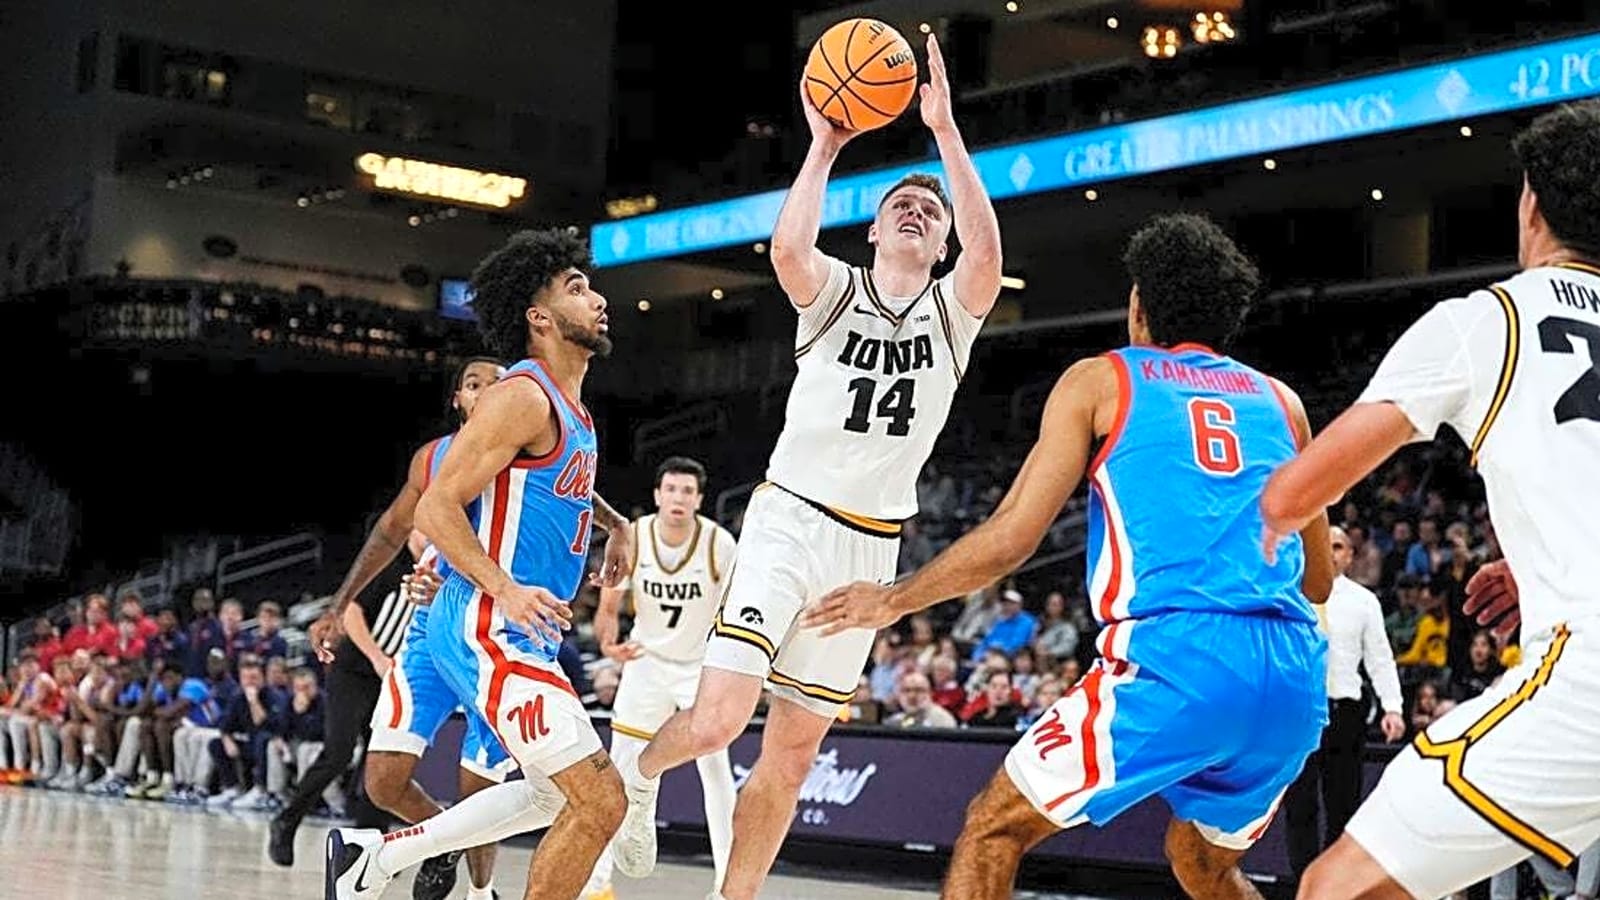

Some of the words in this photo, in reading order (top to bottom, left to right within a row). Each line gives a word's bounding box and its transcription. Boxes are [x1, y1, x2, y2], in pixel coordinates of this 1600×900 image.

[1267, 89, 1395, 143] SPRINGS
[837, 330, 934, 375] IOWA
[843, 377, 916, 437] 14
[1187, 396, 1244, 477] 6
[643, 579, 702, 600] IOWA
[660, 603, 683, 629] 7
